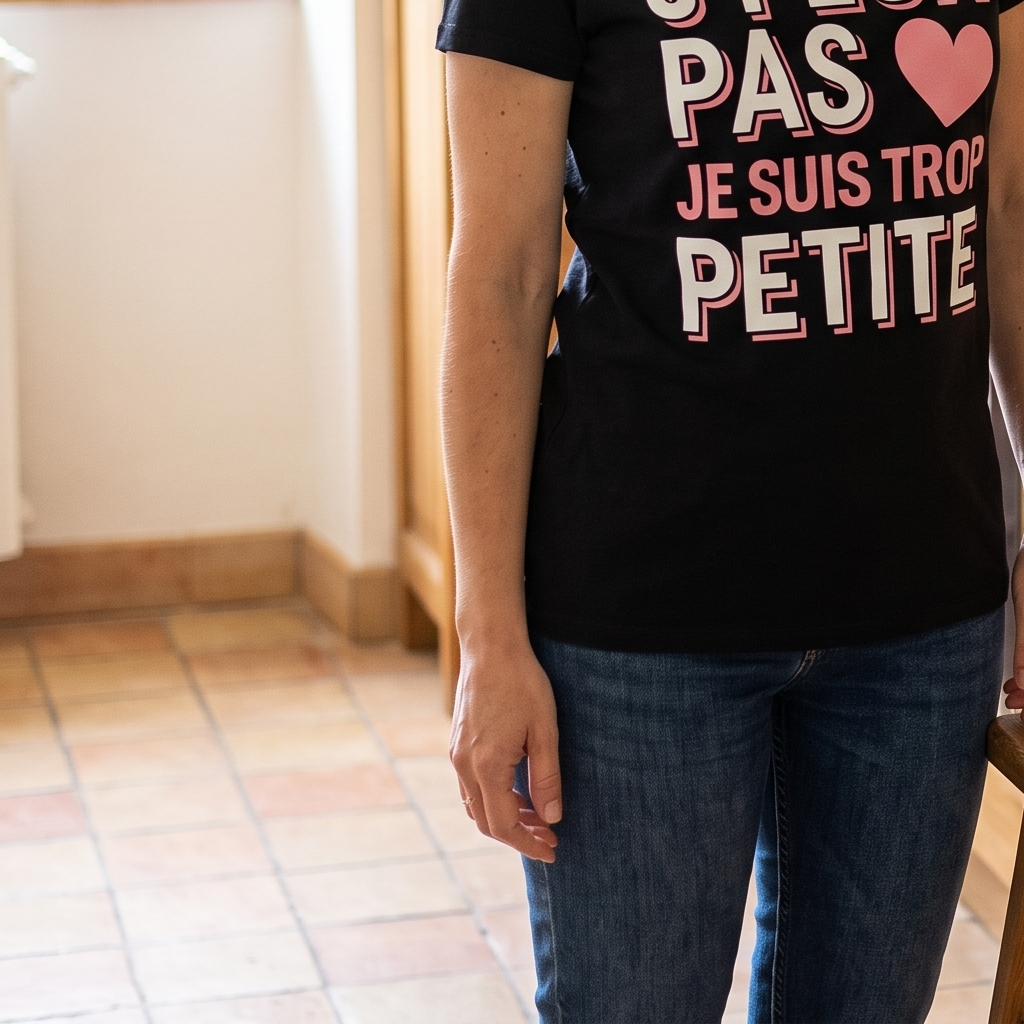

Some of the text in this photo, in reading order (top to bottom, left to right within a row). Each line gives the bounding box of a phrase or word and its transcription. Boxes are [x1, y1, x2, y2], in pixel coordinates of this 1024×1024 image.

[660, 23, 874, 147] PAS
[677, 135, 985, 221] JE SUIS TROP
[676, 205, 978, 342] PETITE
